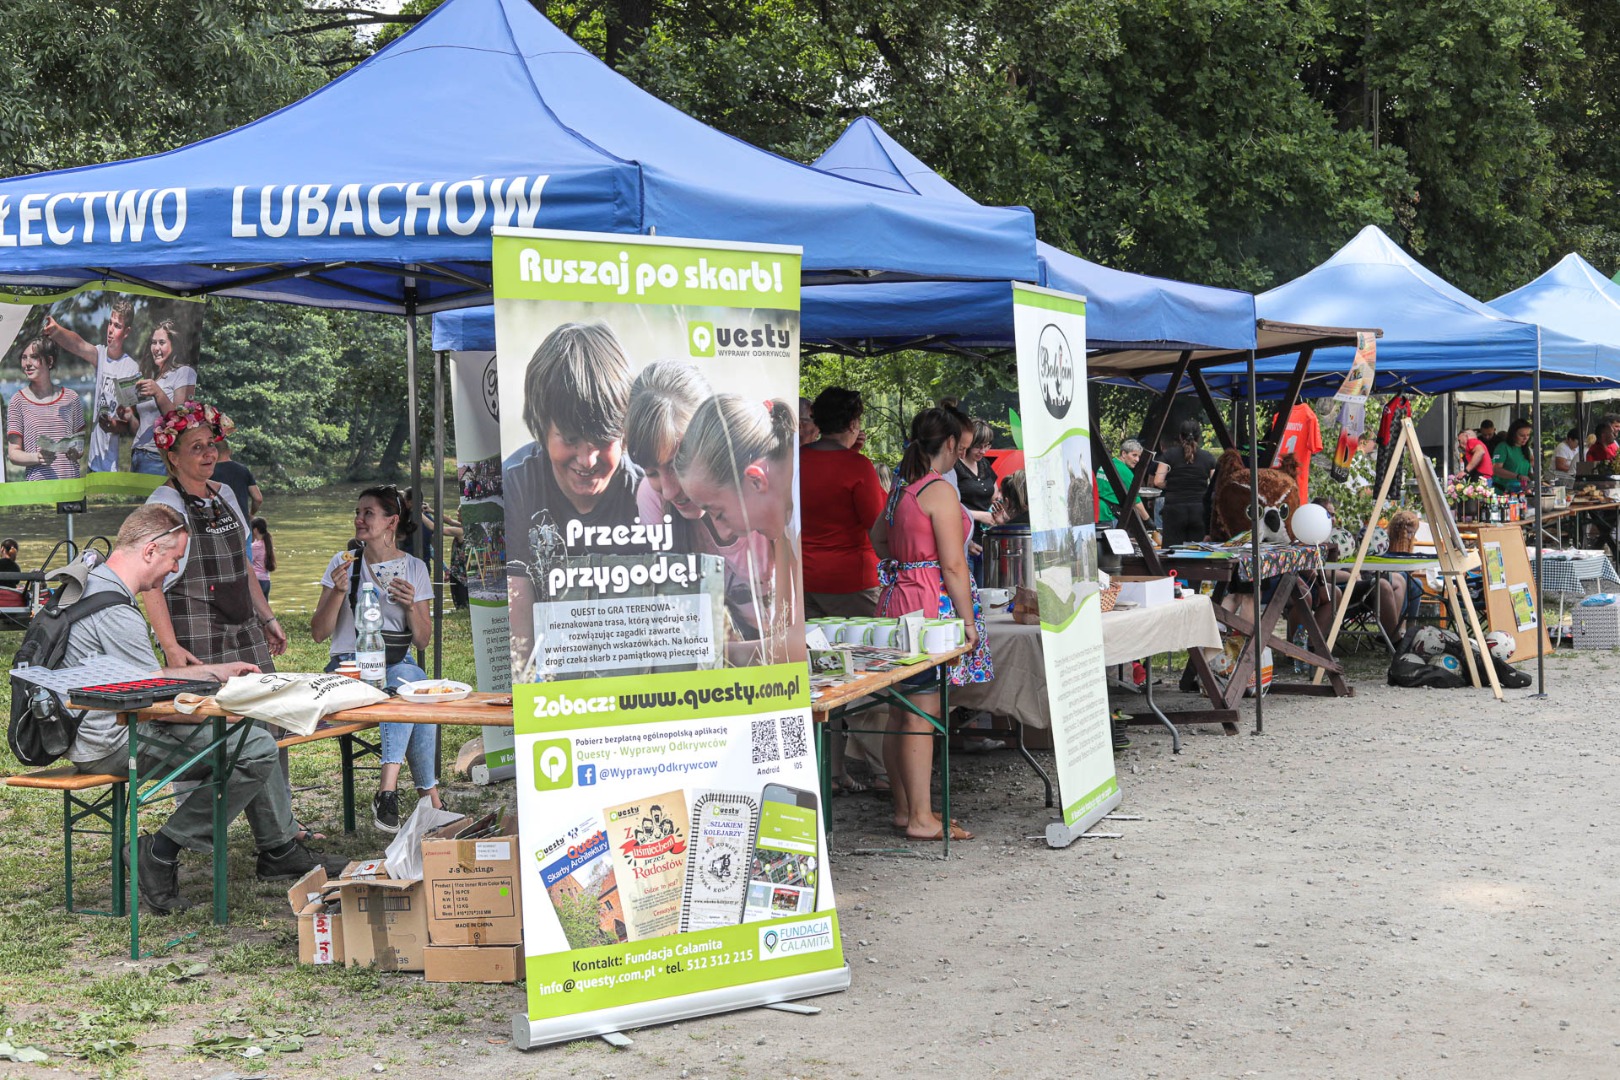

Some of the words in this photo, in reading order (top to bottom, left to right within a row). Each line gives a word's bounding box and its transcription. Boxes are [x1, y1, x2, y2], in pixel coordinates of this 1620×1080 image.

[231, 173, 550, 239] LUBACHÓW
[519, 248, 630, 295] Ruszaj
[636, 262, 679, 295] po
[685, 257, 783, 294] skarb!
[692, 323, 791, 352] Questy
[717, 349, 750, 358] WYPRAWY
[752, 349, 791, 358] ODKRYWCÓW
[566, 513, 674, 551] Przeżyj
[548, 554, 698, 596] przygodę!
[549, 617, 604, 630] nieznakowana
[604, 617, 627, 628] trasa,
[628, 614, 650, 628] którą
[651, 612, 686, 627] wędruje
[686, 612, 702, 624] się,
[570, 606, 596, 617] QUEST
[597, 607, 606, 615] to
[607, 605, 625, 616] GRA
[625, 603, 671, 614] TERENOWA
[545, 646, 552, 654] w
[553, 640, 612, 653] wierszowanych
[612, 636, 670, 650] wskazówkach.
[671, 637, 683, 646] Na
[683, 634, 709, 646] końcu
[568, 629, 615, 642] rozwiązując
[615, 627, 648, 640] zagadki
[648, 626, 681, 637] zawarte
[545, 655, 566, 667] drogi
[566, 655, 588, 665] czeka
[589, 651, 611, 663] skarb
[618, 649, 668, 662] pamiątkową
[668, 646, 710, 660] pieczęcią!
[533, 694, 617, 718] Zobacz:
[618, 675, 800, 712] www.questy.com.pl
[575, 735, 604, 746] Pobierz
[604, 732, 641, 744] bezpłatną
[642, 728, 693, 742] ogólnopolską
[694, 725, 728, 739] aplikację
[576, 748, 612, 762] Questy
[619, 743, 667, 758] Wyprawy
[668, 738, 728, 754] Odkrywców
[599, 758, 719, 782] @WyprawyOdkrywcow
[757, 766, 780, 776] Android
[567, 829, 605, 860] Quest
[624, 827, 634, 840] Z
[547, 864, 570, 883] Skarby
[570, 841, 609, 868] Architektury
[632, 858, 684, 880] Radostów
[643, 855, 666, 867] przez
[780, 921, 830, 939] FUNDACJA
[780, 934, 831, 953] CALAMITA
[572, 954, 623, 973] Kontakt:
[625, 946, 673, 967] Fundacja
[675, 938, 723, 958] Calamita
[540, 967, 656, 997] info@questy.com.pl
[665, 961, 685, 975] tel.
[687, 958, 709, 971] 512
[710, 953, 732, 967] 312
[733, 949, 754, 963] 215
